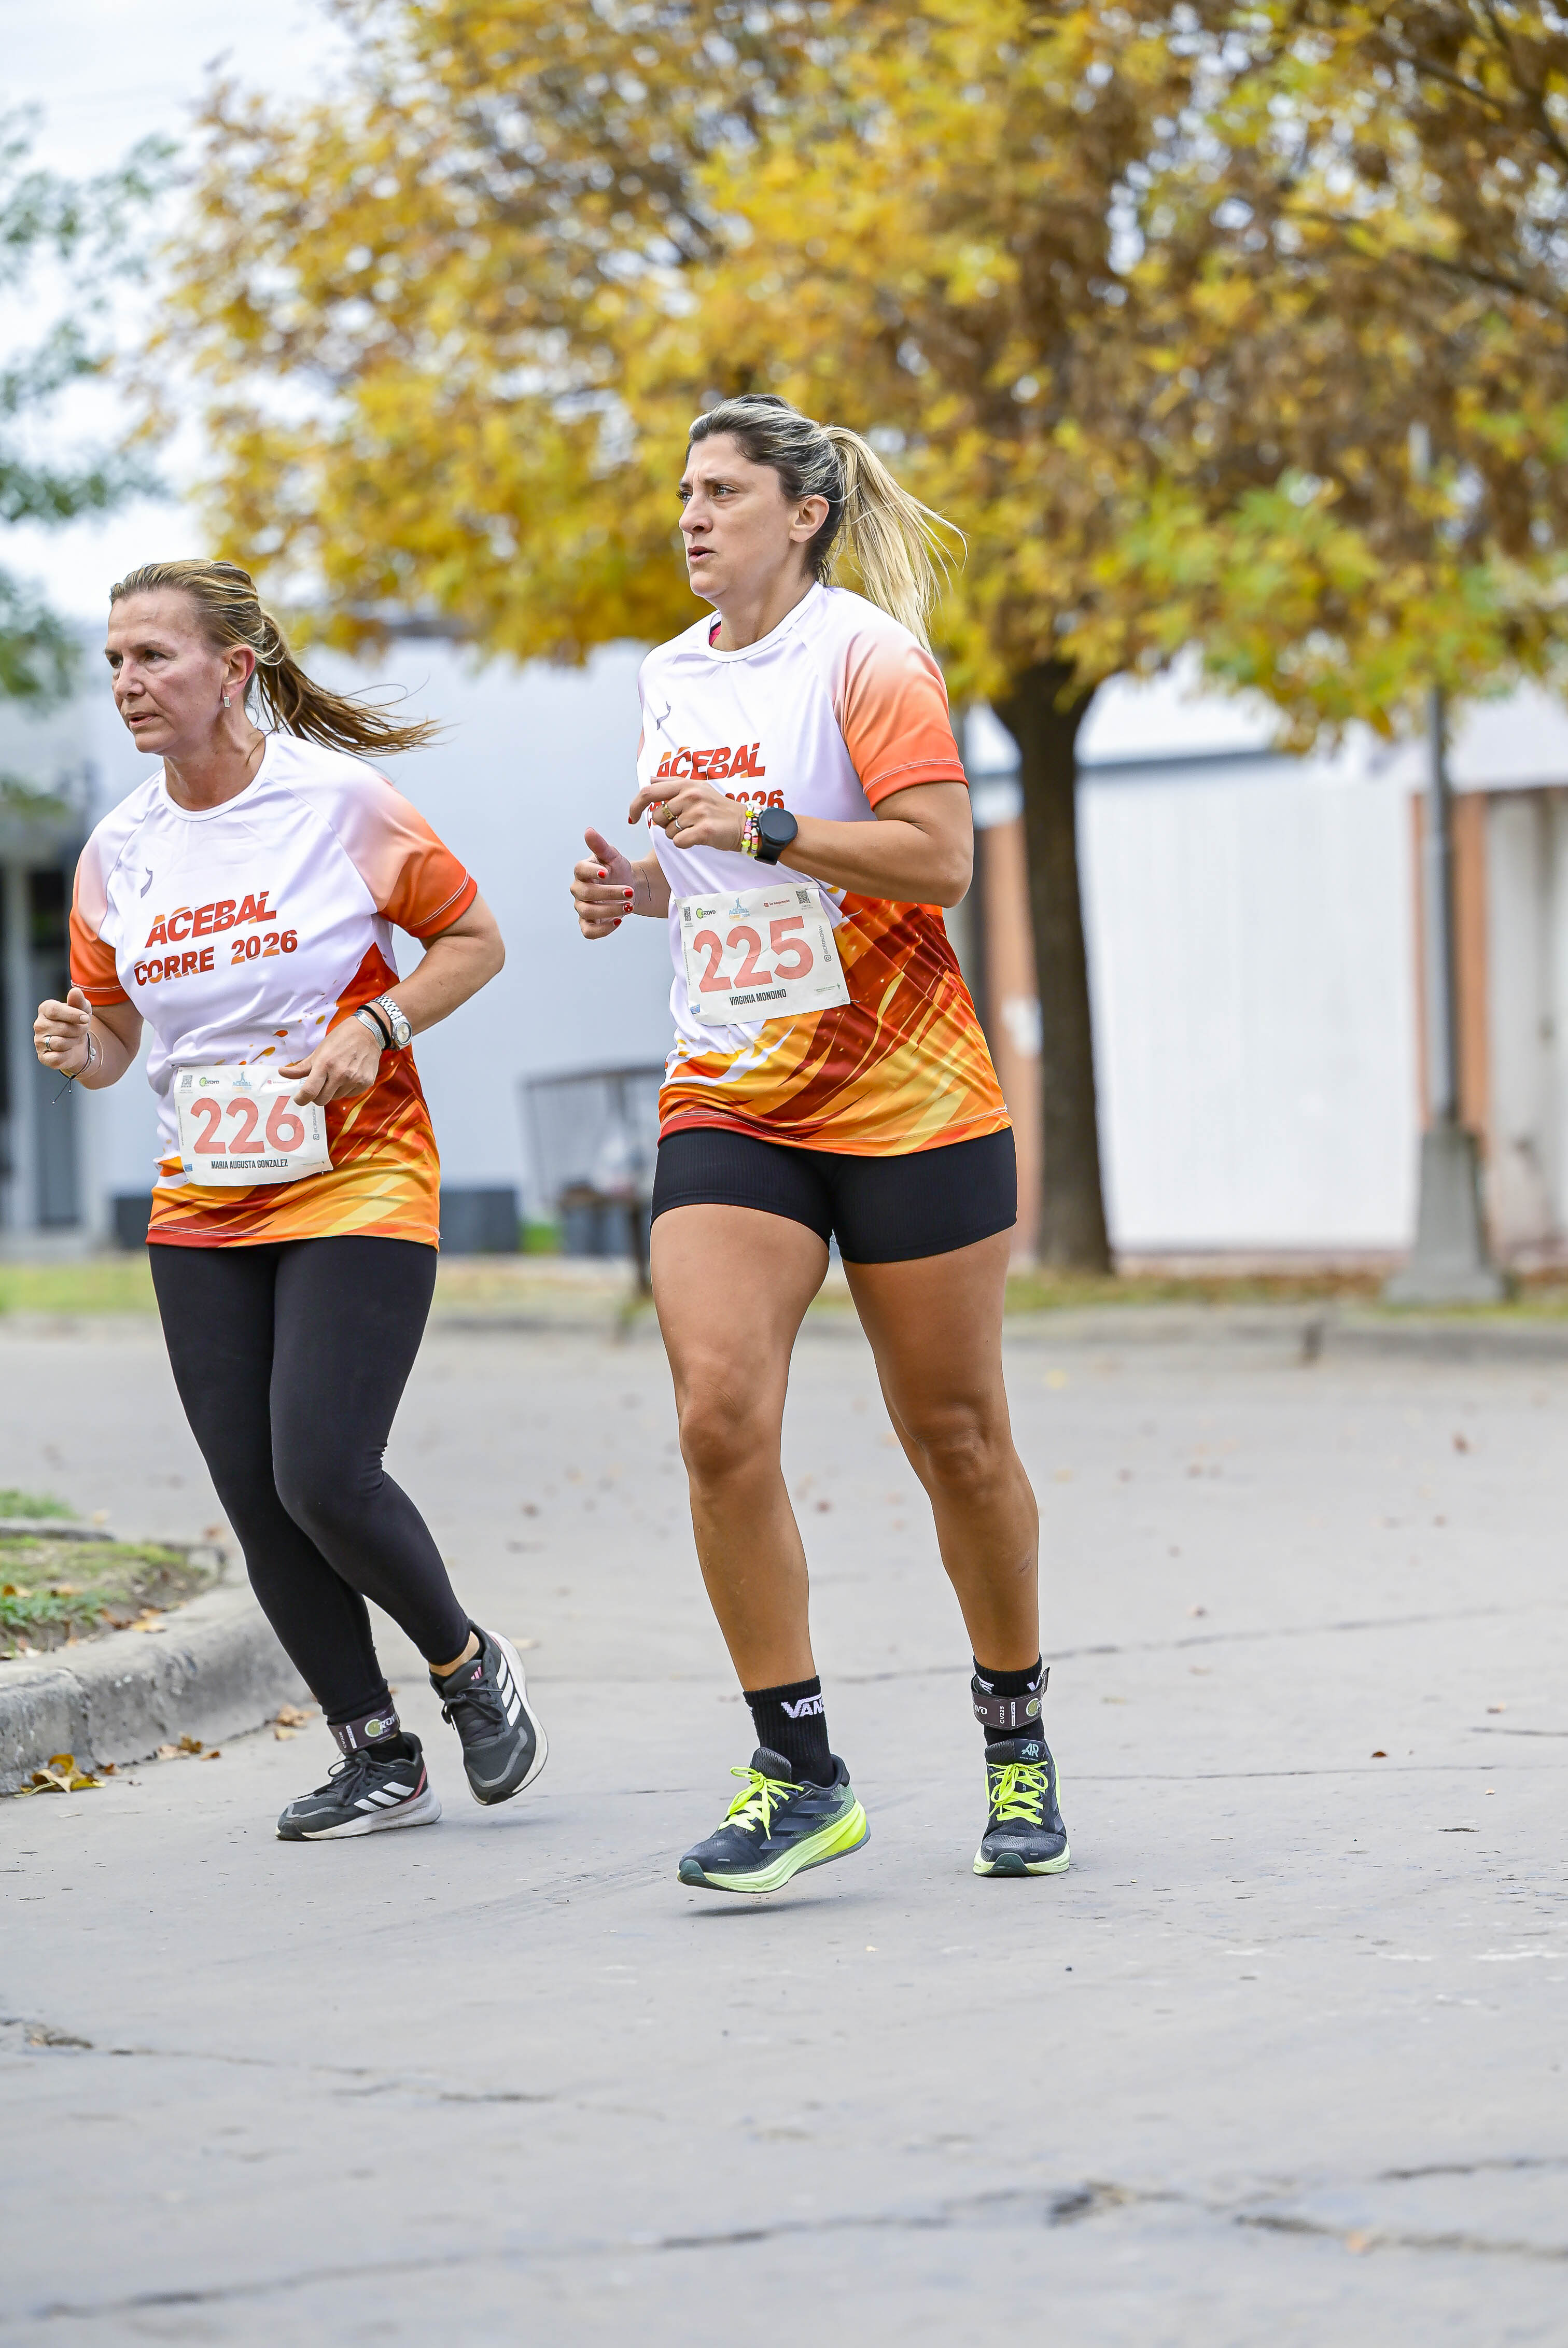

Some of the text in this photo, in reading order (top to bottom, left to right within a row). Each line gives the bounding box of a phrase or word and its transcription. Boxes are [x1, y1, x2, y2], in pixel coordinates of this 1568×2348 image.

[656, 743, 765, 780] ACEBAL
[145, 891, 276, 948] ACEBAL
[134, 929, 298, 986] CORRE 2026
[693, 916, 814, 993] 225
[730, 988, 787, 1005] VIRGINIA MONDINO
[190, 1096, 305, 1154] 226
[211, 1159, 288, 1169] MARIA AUGUSTA GONZALEZ
[781, 1693, 824, 1718] VAN
